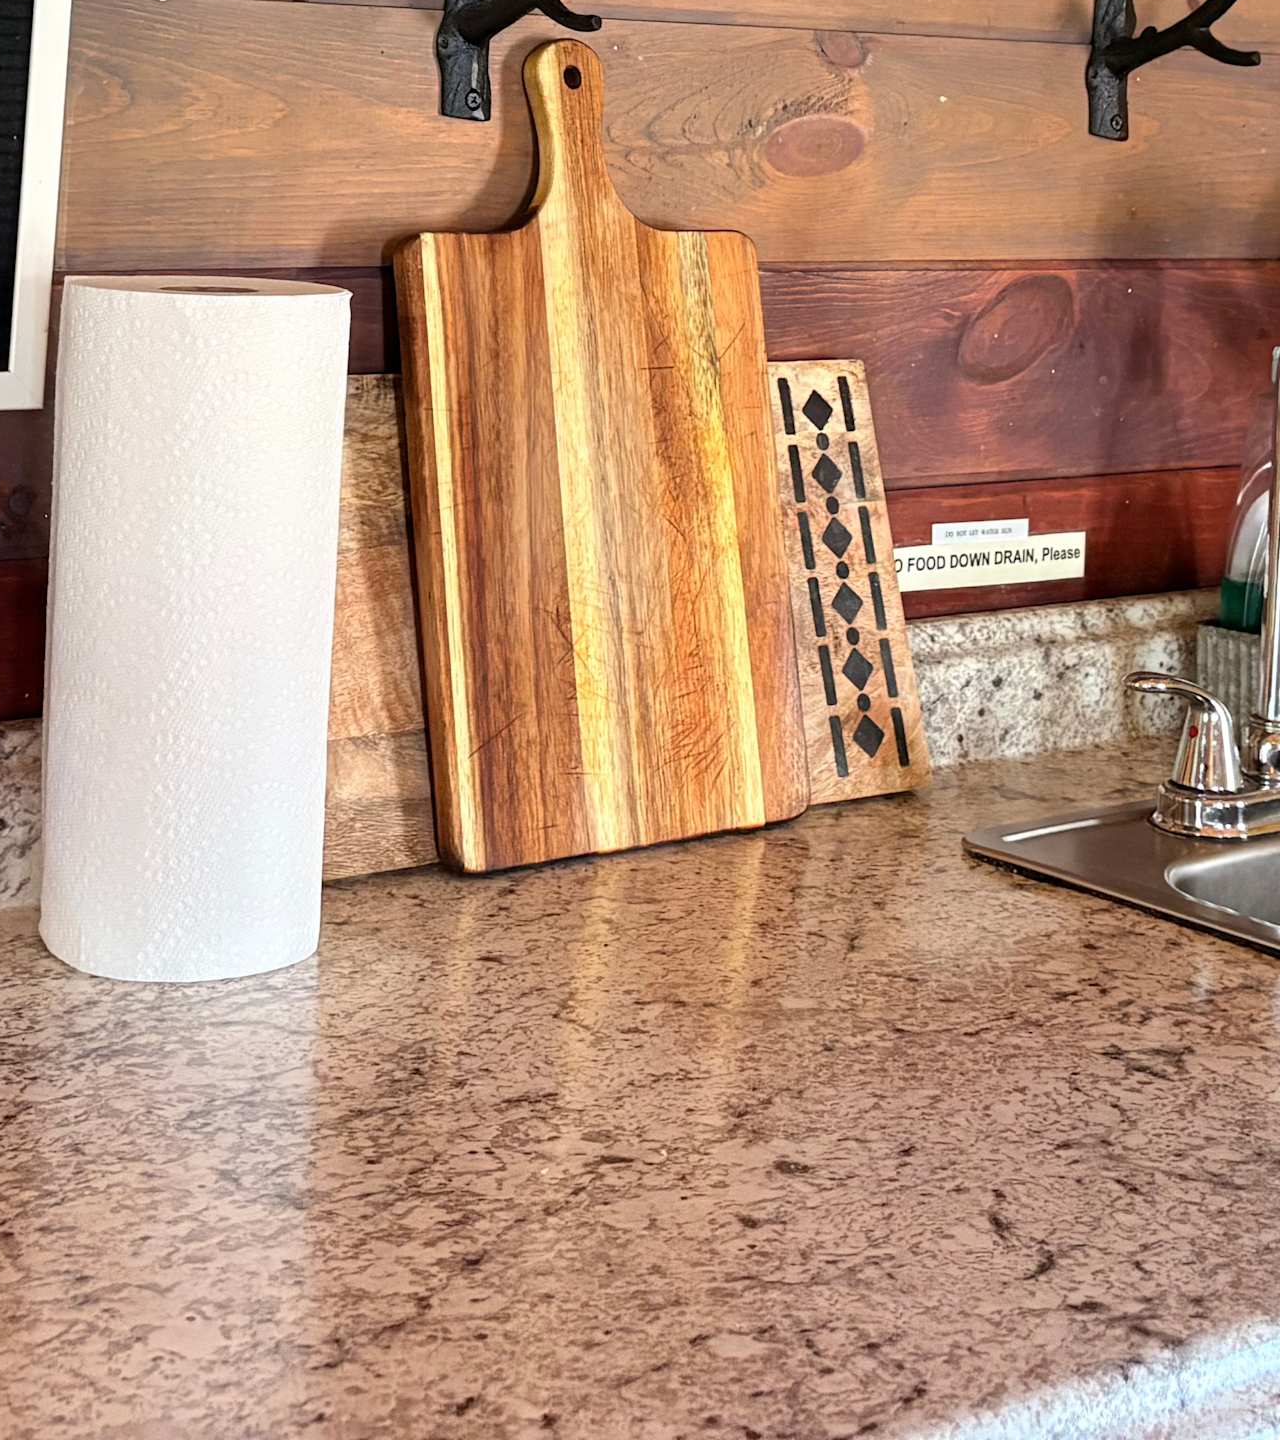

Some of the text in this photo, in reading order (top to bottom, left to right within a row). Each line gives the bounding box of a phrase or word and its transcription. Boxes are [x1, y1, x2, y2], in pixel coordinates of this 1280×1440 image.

[907, 555, 946, 573] FOOD
[950, 551, 990, 569] DOWN
[994, 548, 1038, 565] DRAIN,
[1042, 546, 1081, 562] Please
